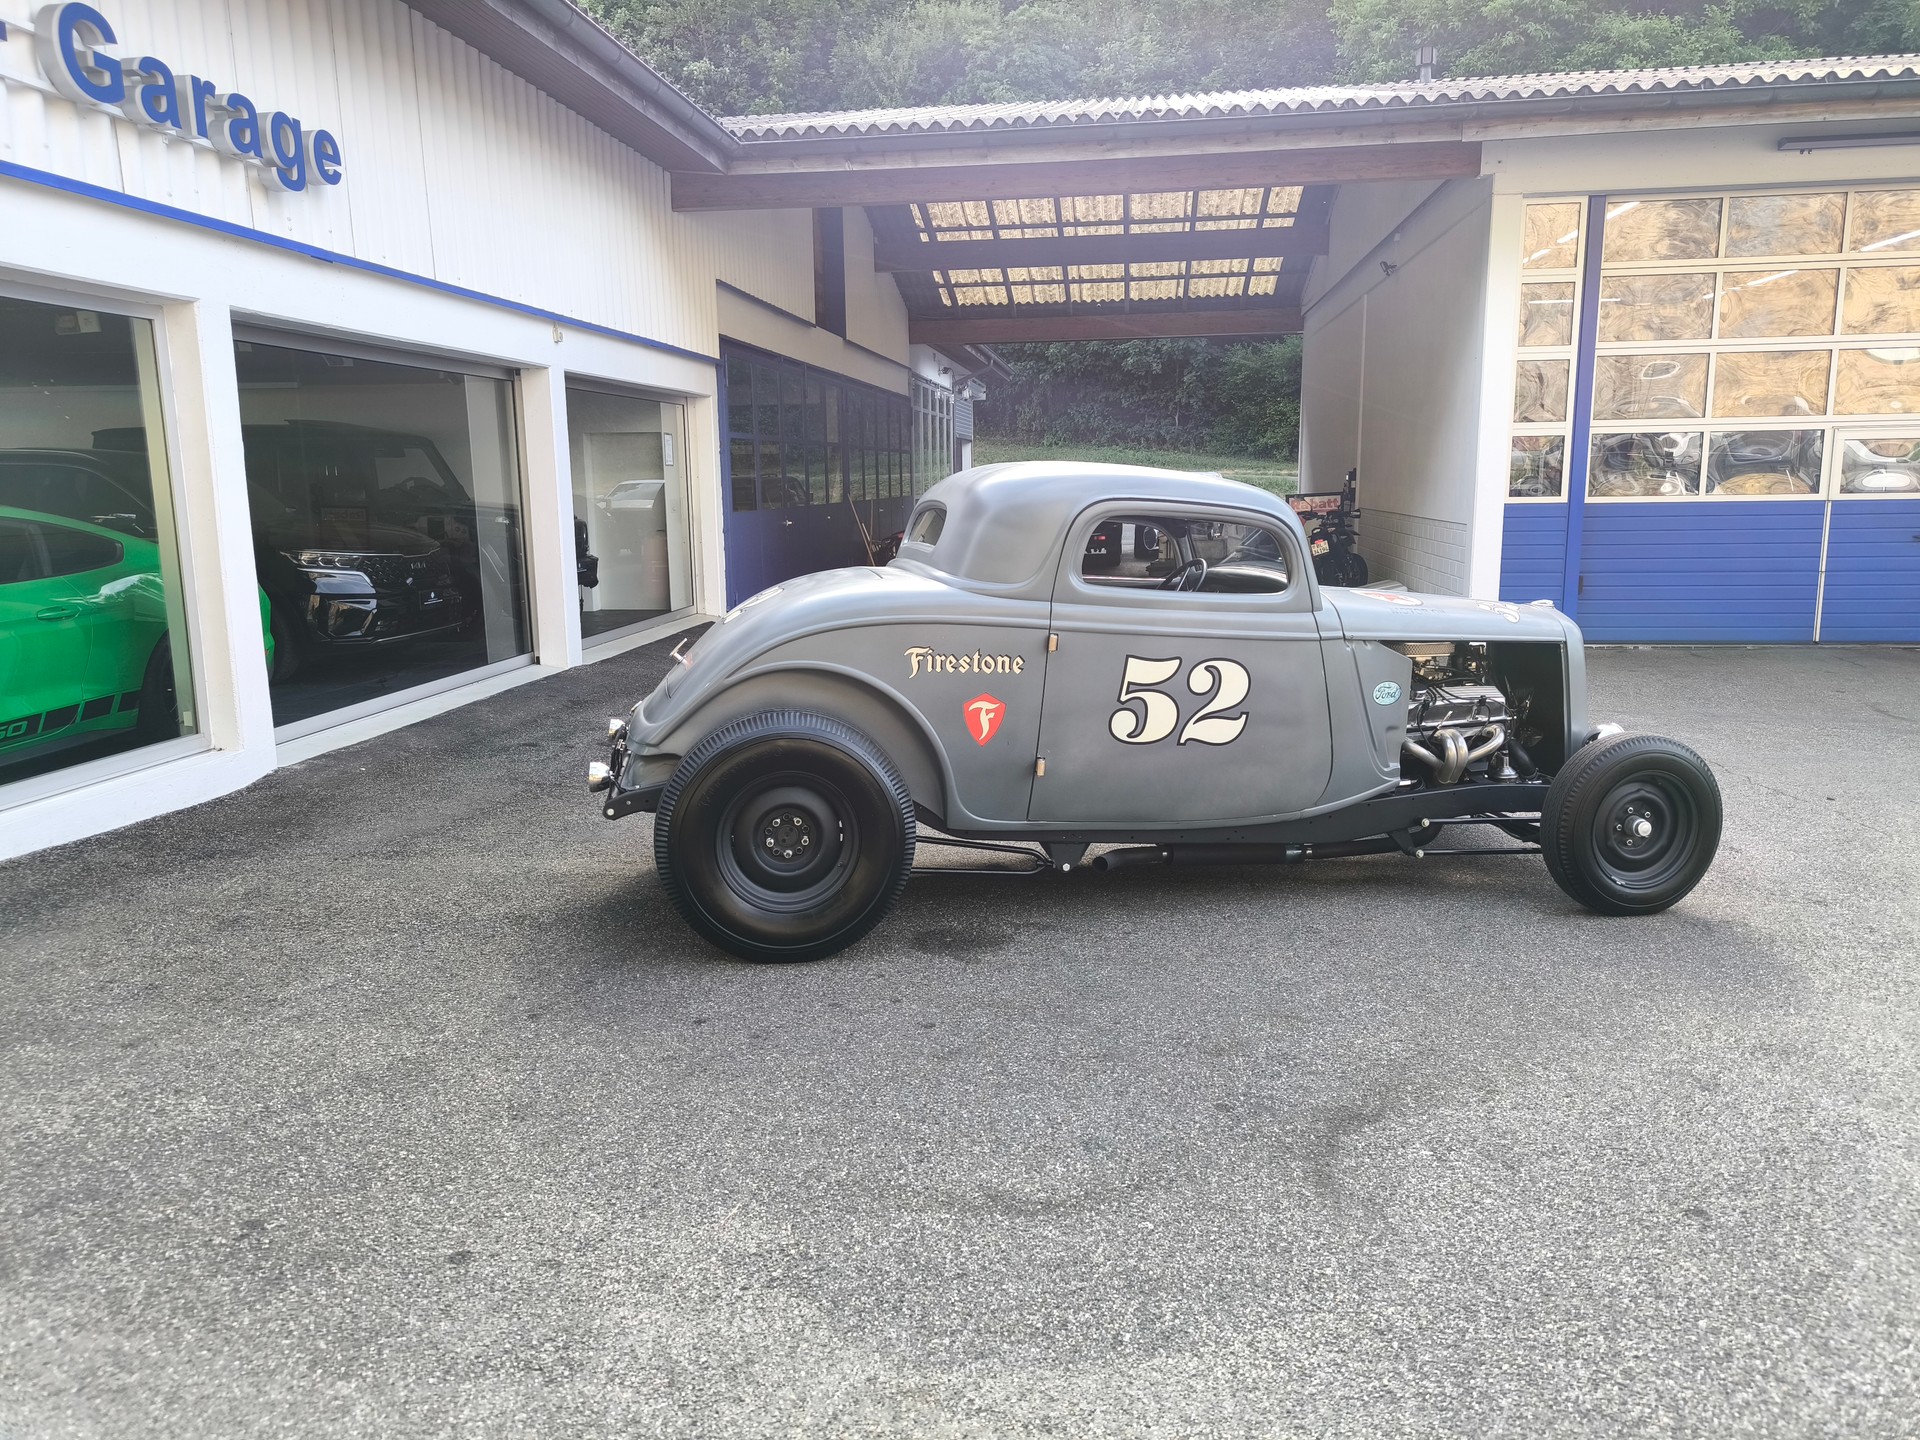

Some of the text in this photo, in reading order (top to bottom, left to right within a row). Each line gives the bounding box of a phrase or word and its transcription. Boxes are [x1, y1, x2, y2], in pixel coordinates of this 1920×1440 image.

[40, 2, 342, 192] Garage
[1290, 498, 1339, 509] Rabatt
[903, 646, 1026, 679] Firestone
[1108, 654, 1252, 746] 52
[1374, 684, 1401, 701] Ford
[967, 700, 1001, 741] F
